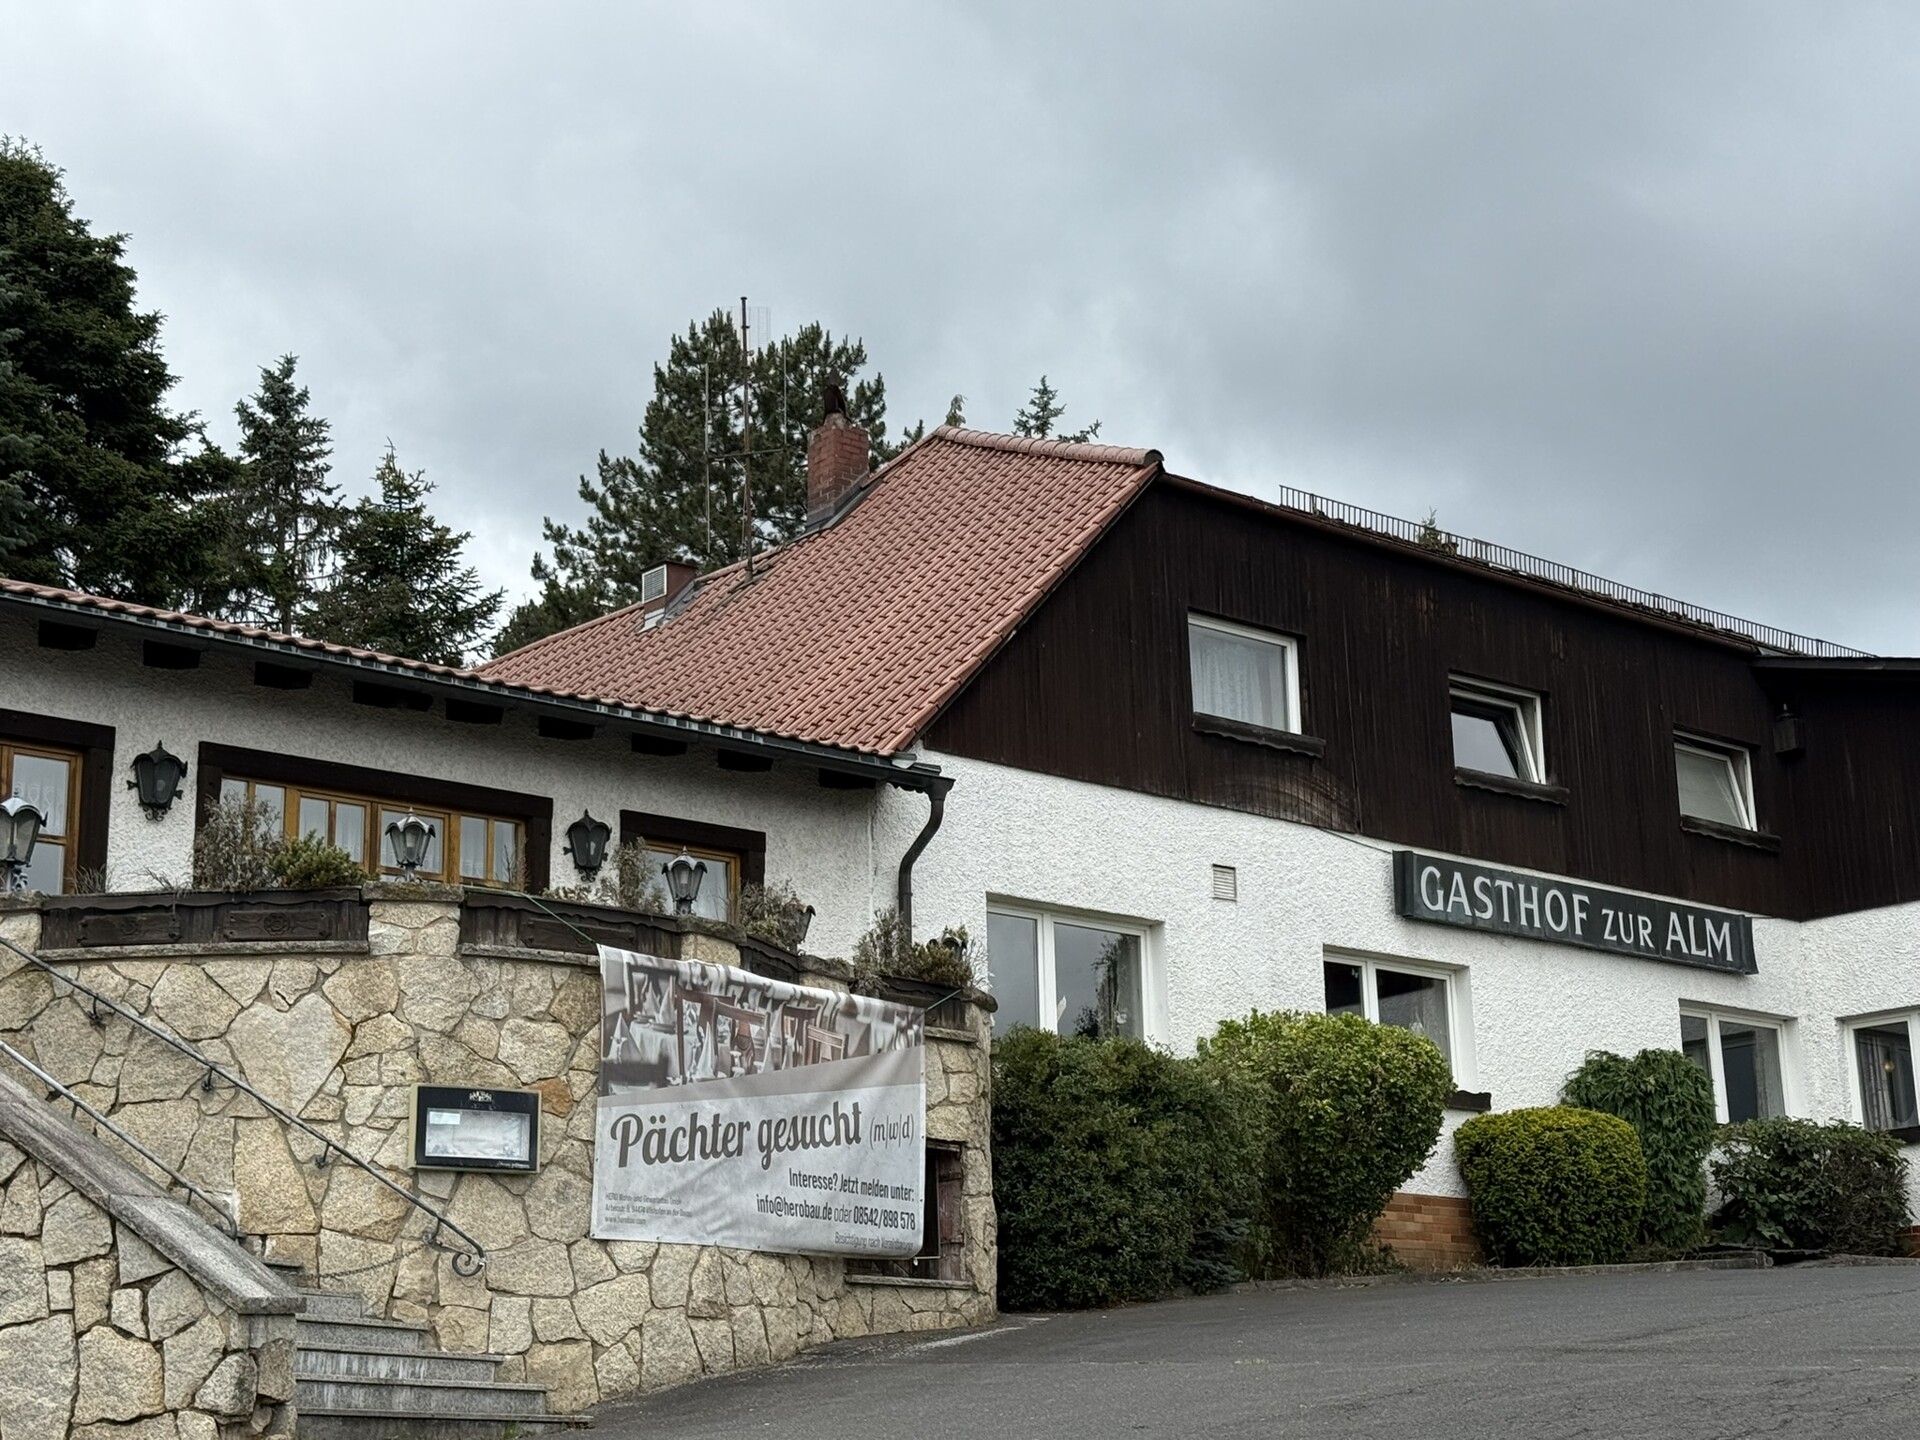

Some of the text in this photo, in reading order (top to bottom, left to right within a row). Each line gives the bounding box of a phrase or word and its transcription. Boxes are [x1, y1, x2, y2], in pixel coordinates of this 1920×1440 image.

[1420, 865, 1734, 962] GASTHOF ZUR ALM
[610, 1111, 750, 1168] Pächter
[757, 1101, 862, 1170] gesucht
[789, 1168, 915, 1202] Interesse? Jetzt melden unter:
[756, 1194, 916, 1231] info@herobau.de oder 08542/898 578
